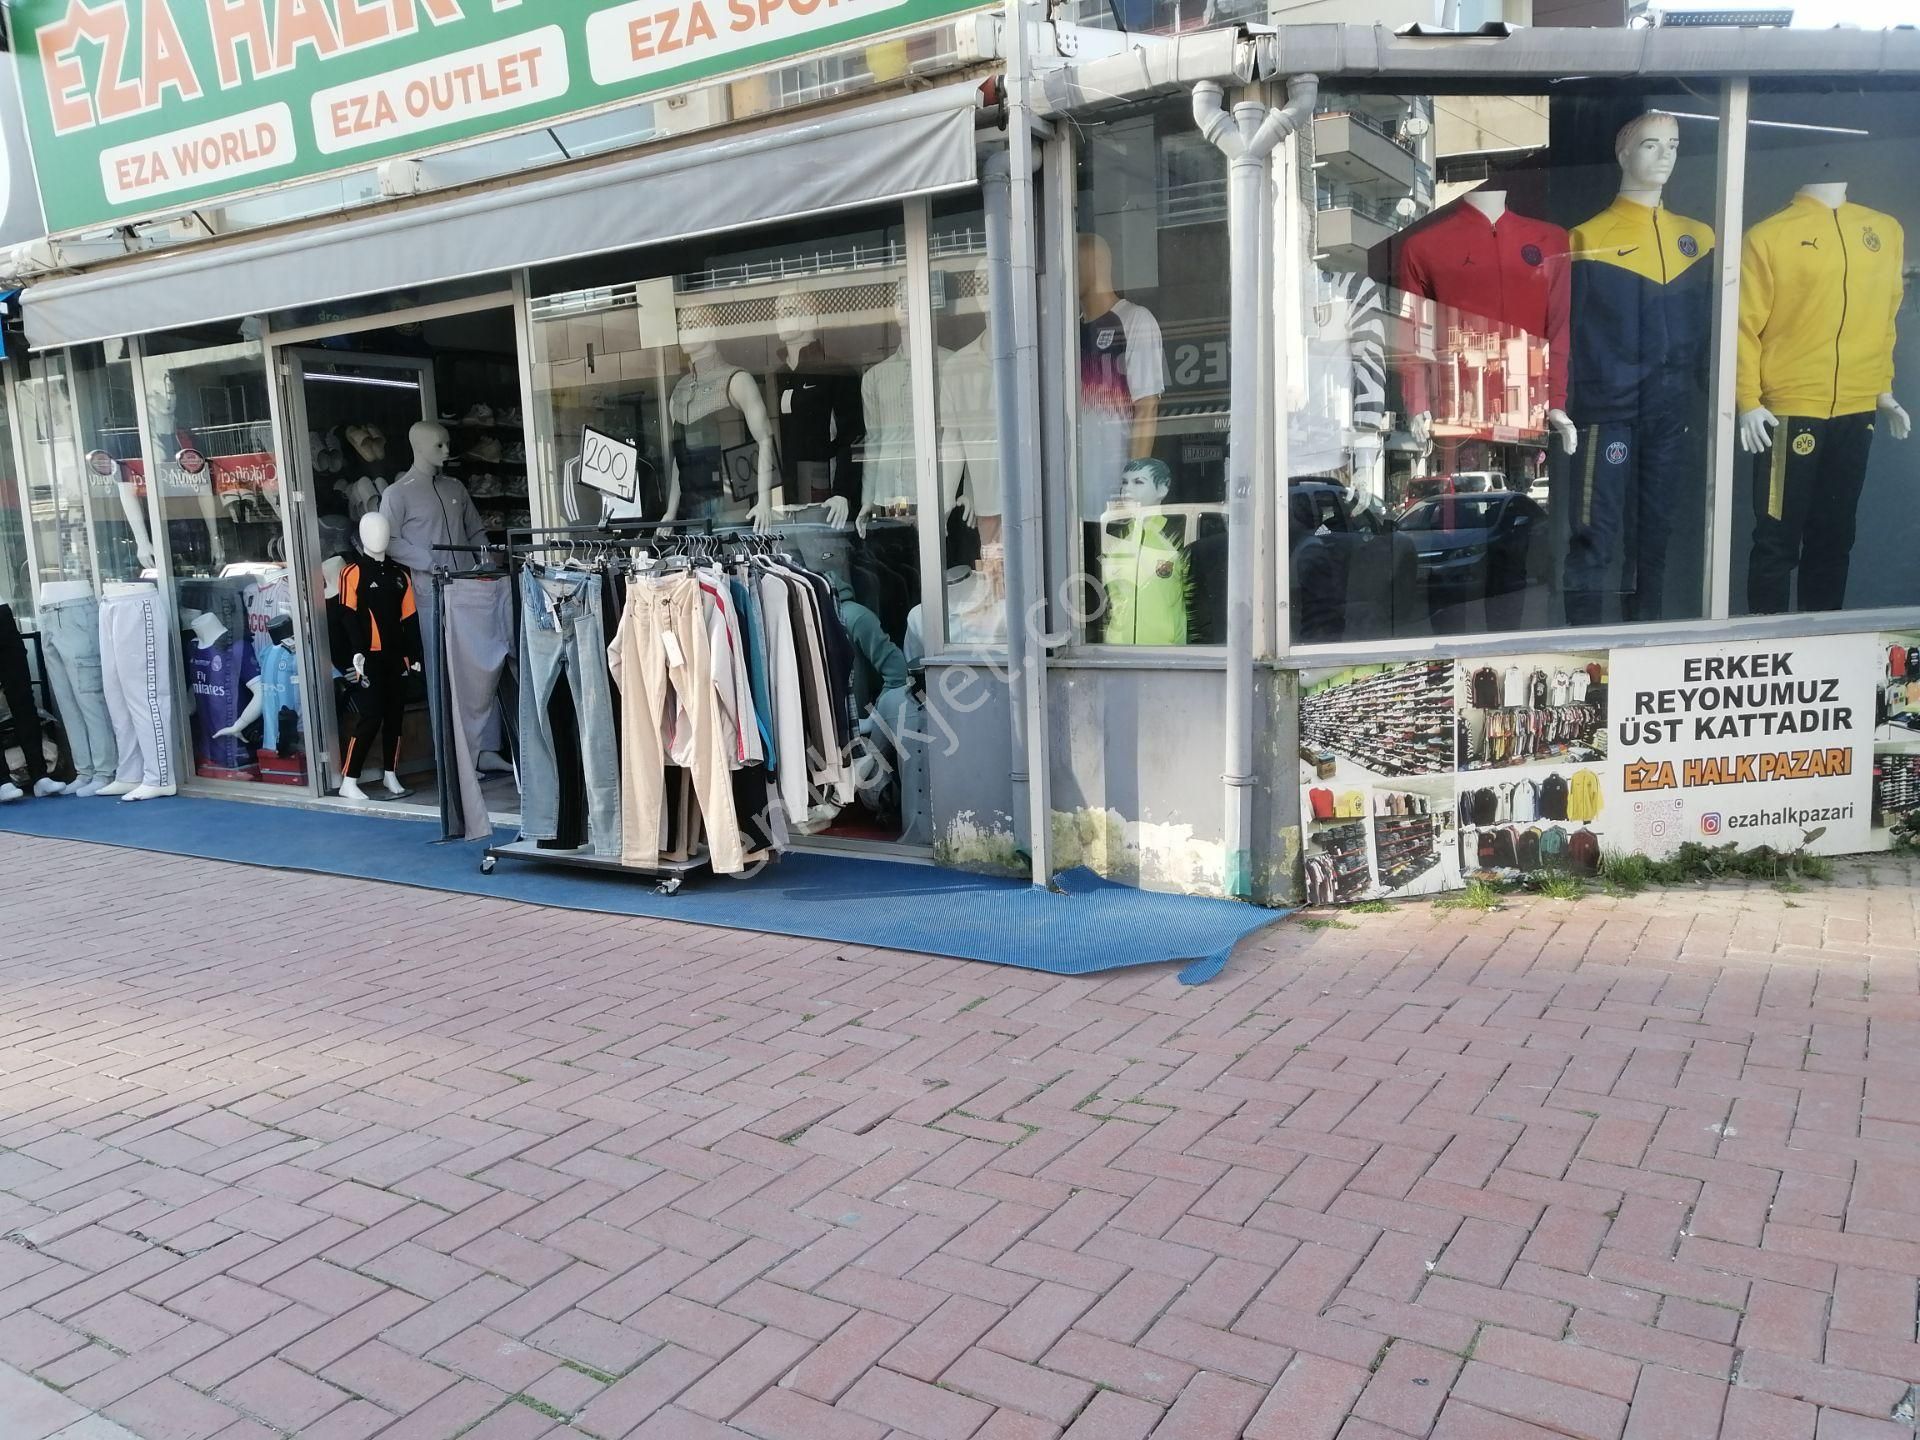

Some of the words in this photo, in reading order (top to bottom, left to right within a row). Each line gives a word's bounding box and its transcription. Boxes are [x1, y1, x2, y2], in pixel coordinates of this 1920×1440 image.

[629, 1, 718, 62] EZA
[36, 0, 204, 137] EZA
[330, 90, 398, 138] EZA
[404, 47, 543, 119] OUTLET
[115, 150, 169, 191] EZA
[172, 122, 277, 175] WORLD
[586, 437, 628, 481] 200
[1684, 652, 1793, 682] ERKEK
[1635, 679, 1839, 715] REYONUMUZ
[1620, 717, 1683, 746] ÜST
[1695, 707, 1853, 741] KATTADIR
[1623, 756, 1678, 793] EZA
[1683, 754, 1757, 788] HALK
[1759, 747, 1853, 781] PAZARI
[1728, 802, 1854, 829] ezahalkpazari
